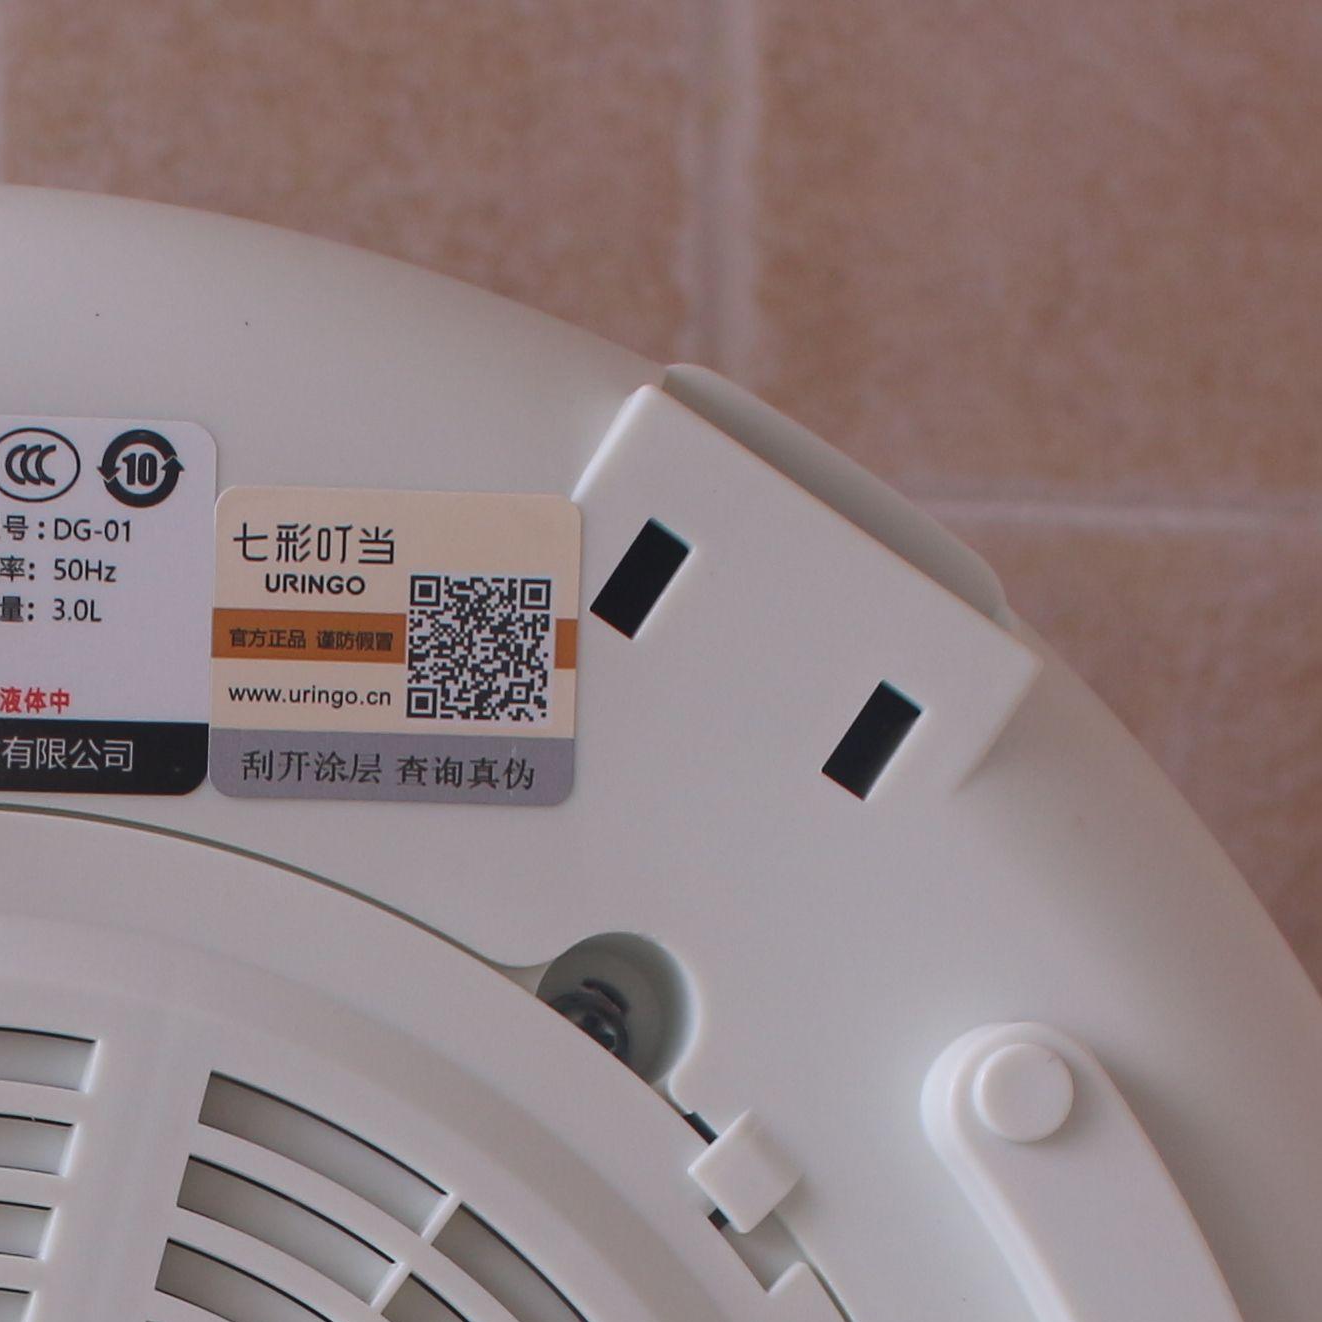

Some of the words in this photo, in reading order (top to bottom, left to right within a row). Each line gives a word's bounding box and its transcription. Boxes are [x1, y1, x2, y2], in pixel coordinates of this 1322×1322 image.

[123, 452, 157, 486] 10
[53, 518, 132, 542] DG-01
[233, 522, 395, 564] 七彩叮当
[53, 558, 117, 583] 50Hz
[265, 573, 366, 595] URINGO
[52, 599, 102, 622] 3.0L
[230, 628, 306, 649] 官方正品
[317, 630, 394, 651] 谨防假冒
[228, 685, 391, 709] www.uringo.cn
[241, 750, 382, 784] 刮开涂层
[396, 756, 535, 790] 查询真伪
